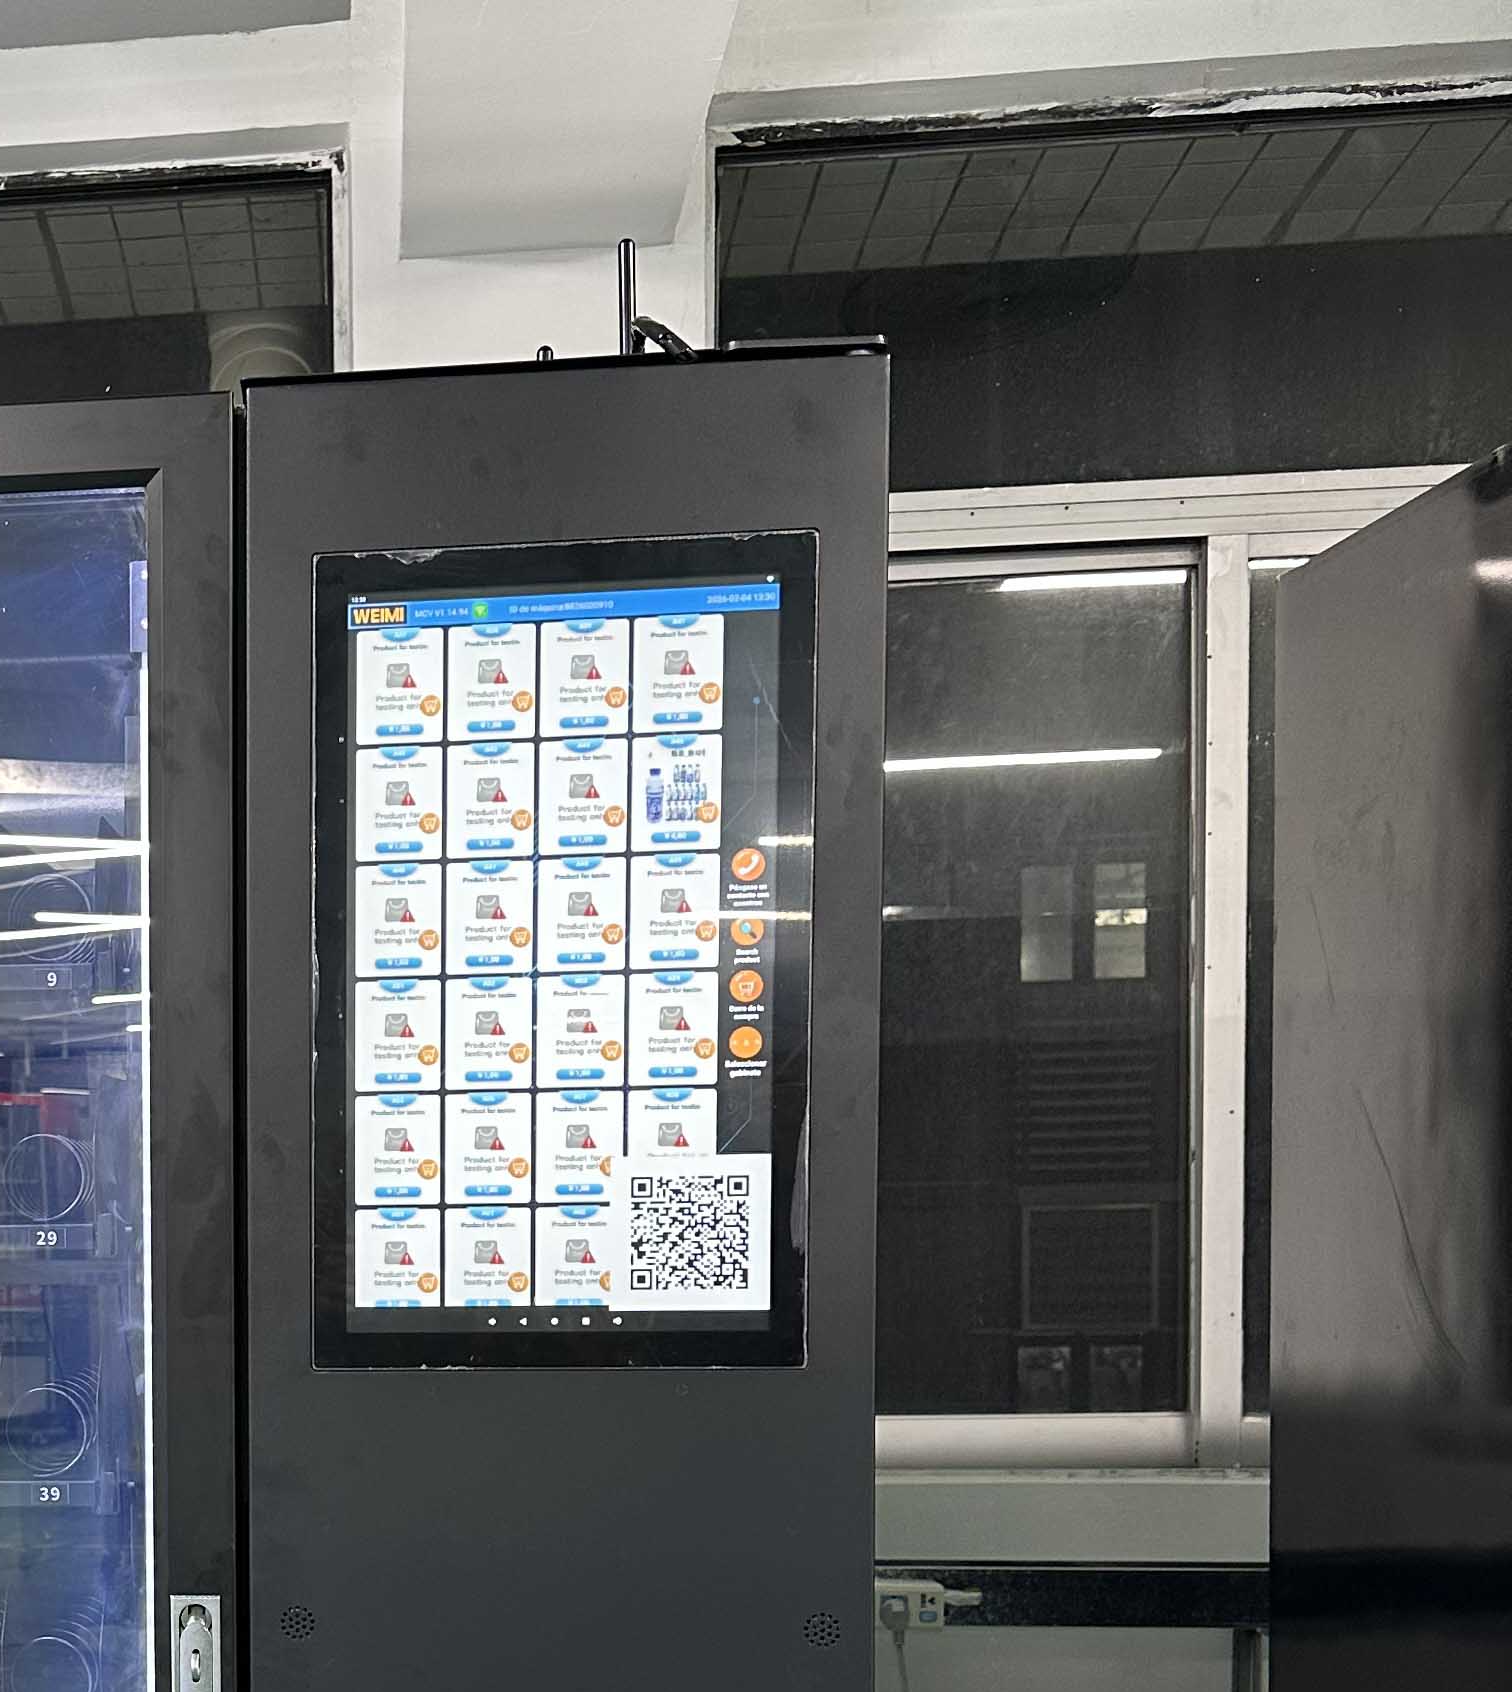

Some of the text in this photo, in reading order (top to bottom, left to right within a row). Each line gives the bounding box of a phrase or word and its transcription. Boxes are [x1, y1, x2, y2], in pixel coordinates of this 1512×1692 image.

[353, 606, 405, 625] WEIMI
[47, 972, 57, 987] 9
[36, 1231, 57, 1246] 29
[39, 1486, 60, 1501] 39
